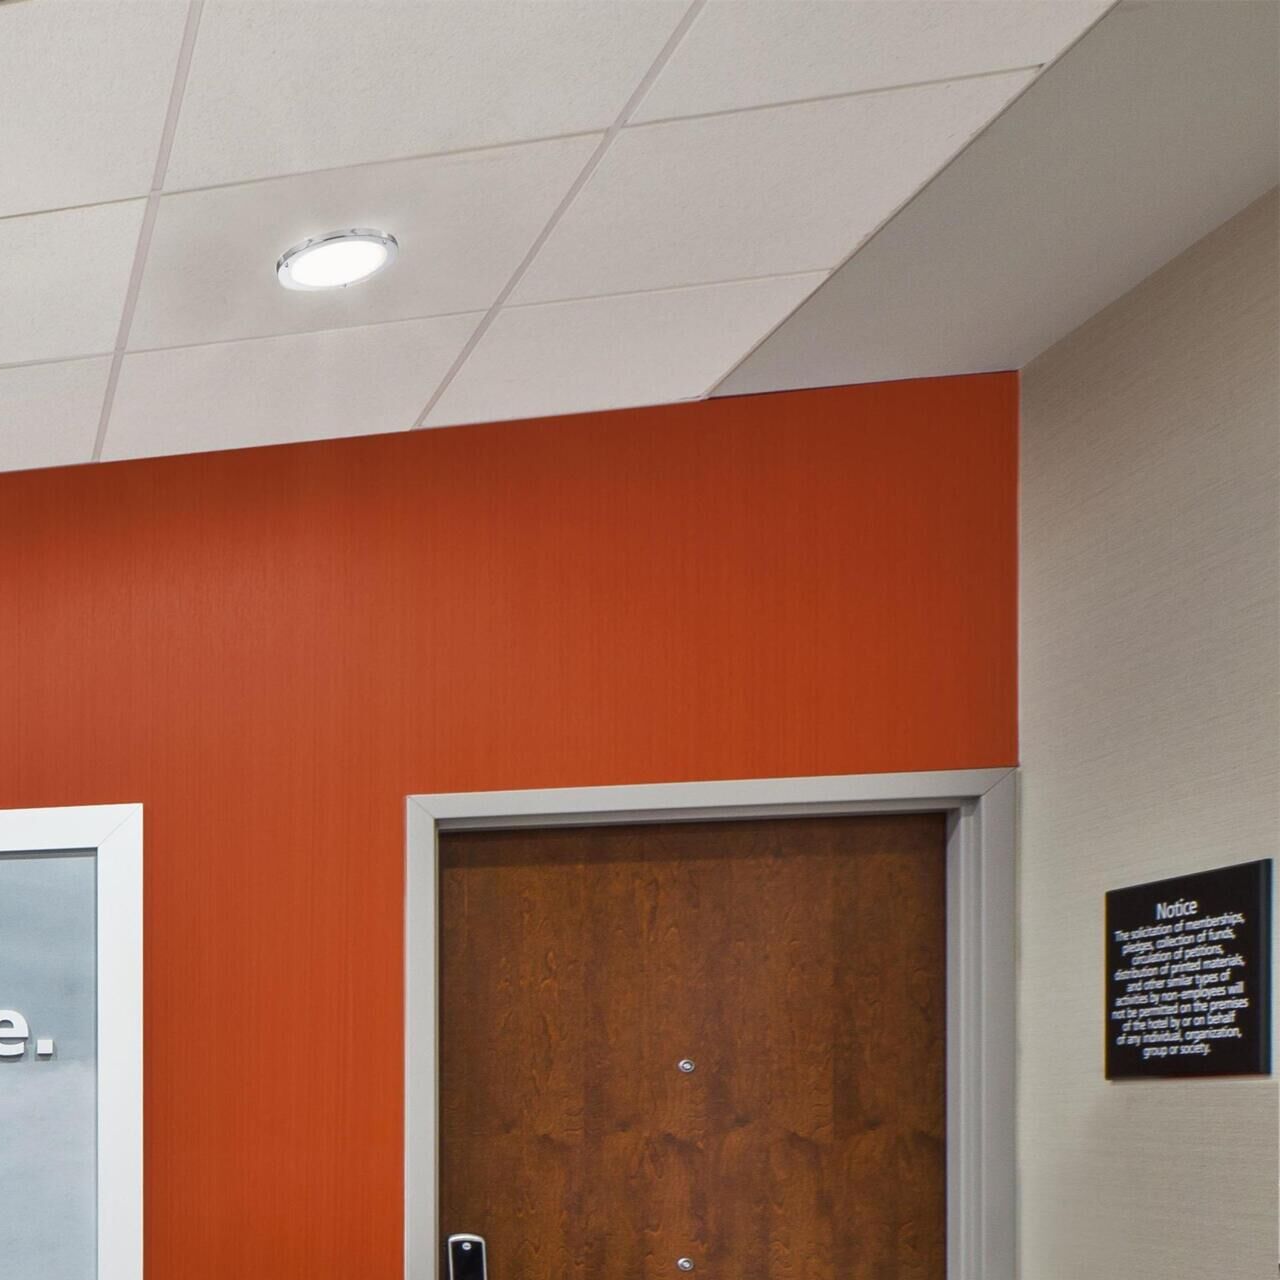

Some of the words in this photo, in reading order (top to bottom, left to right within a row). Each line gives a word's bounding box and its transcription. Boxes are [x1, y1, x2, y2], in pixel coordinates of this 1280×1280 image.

[1156, 898, 1198, 920] Notice
[1114, 931, 1129, 942] The
[1131, 924, 1172, 939] solicitation
[1174, 920, 1184, 932] of
[1185, 912, 1245, 929] memberships,
[1122, 941, 1154, 956] pledges,
[1156, 934, 1195, 948] collection
[1197, 930, 1207, 942] of
[1208, 927, 1236, 940] funds,
[1132, 950, 1172, 965] circulation
[1173, 947, 1183, 959] of
[1184, 944, 1224, 960] petitions,
[1114, 967, 1158, 980] distribution
[1160, 963, 1170, 974] of
[1171, 958, 1201, 977] printed
[1203, 953, 1245, 969] materials,
[1126, 981, 1142, 992] and
[1144, 979, 1165, 990] other
[1166, 975, 1193, 987] similar
[1196, 973, 1218, 989] types
[1220, 969, 1231, 981] of
[1115, 994, 1148, 1007] activities
[1150, 993, 1159, 1005] by
[1161, 985, 1226, 1001] non-employees
[1228, 981, 1244, 994] will
[1112, 1010, 1125, 1019] not
[1127, 1008, 1137, 1018] be
[1139, 1005, 1178, 1019] permitted
[1180, 1004, 1191, 1013] on
[1193, 1001, 1208, 1012] the
[1210, 997, 1249, 1012] premises
[1122, 1021, 1132, 1031] of
[1133, 1021, 1146, 1030] the
[1148, 1019, 1168, 1029] hotel
[1170, 1019, 1180, 1029] by
[1182, 1017, 1192, 1026] or
[1193, 1016, 1205, 1025] on
[1207, 1010, 1236, 1024] behalf
[1116, 1034, 1126, 1045] of
[1127, 1036, 1141, 1046] any
[1143, 1031, 1183, 1043] individual,
[1185, 1026, 1242, 1043] organization,
[1143, 1046, 1167, 1059] group
[1169, 1045, 1179, 1054] or
[1180, 1042, 1211, 1055] society.
